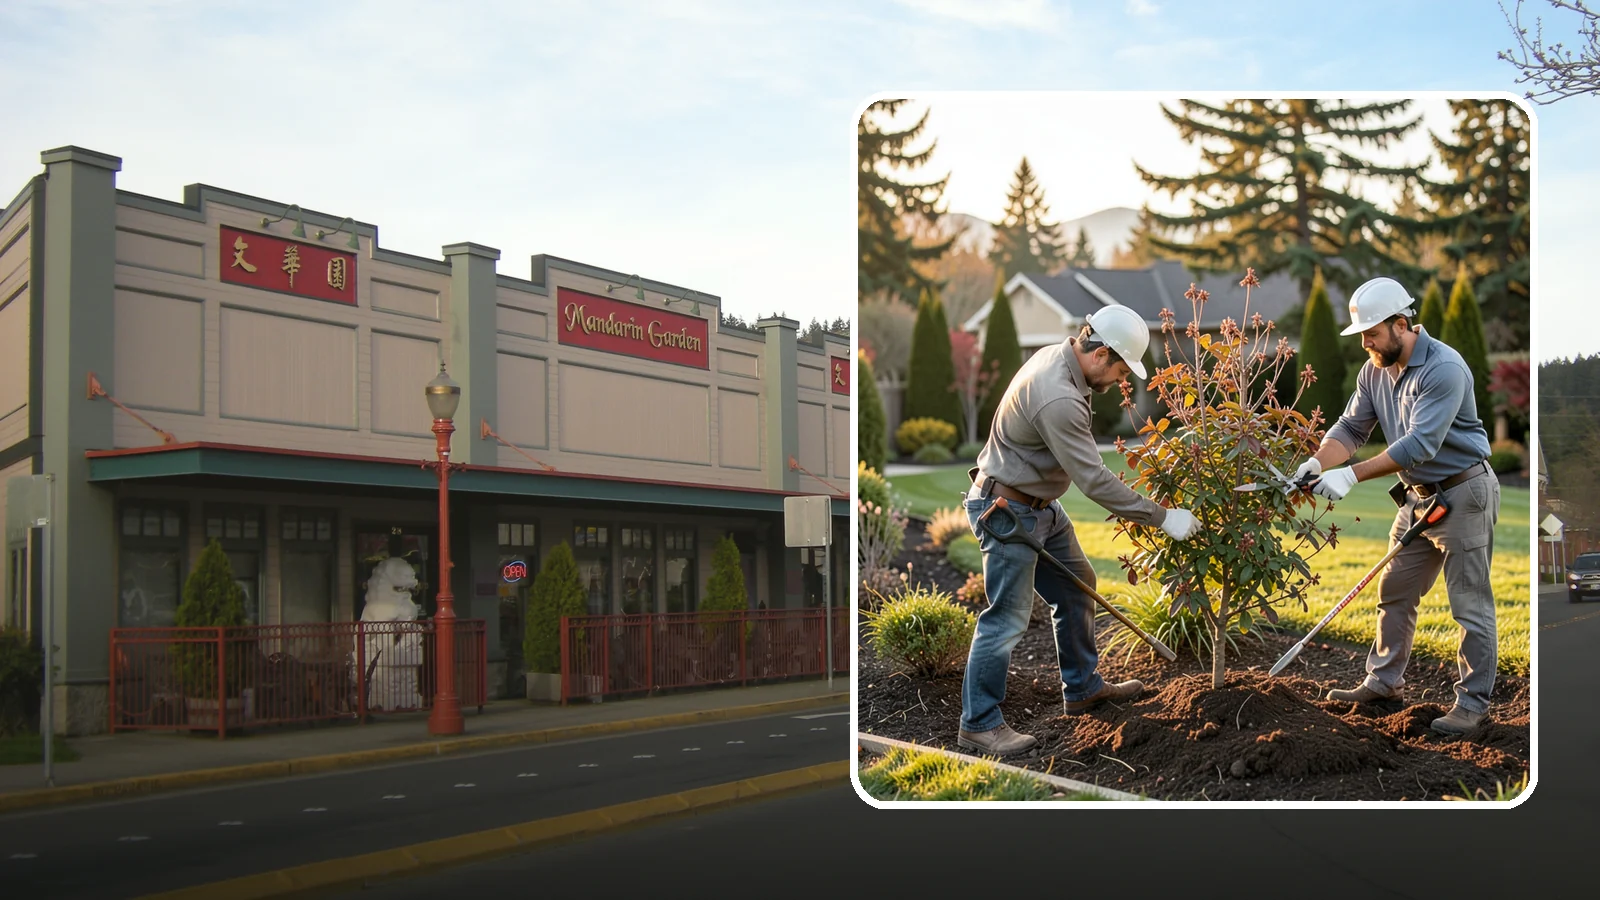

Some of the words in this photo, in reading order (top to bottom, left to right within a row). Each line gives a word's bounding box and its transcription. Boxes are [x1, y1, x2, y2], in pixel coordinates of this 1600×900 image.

[564, 302, 644, 341] Mandarin
[648, 320, 702, 352] Garden
[503, 565, 527, 578] OPEN
